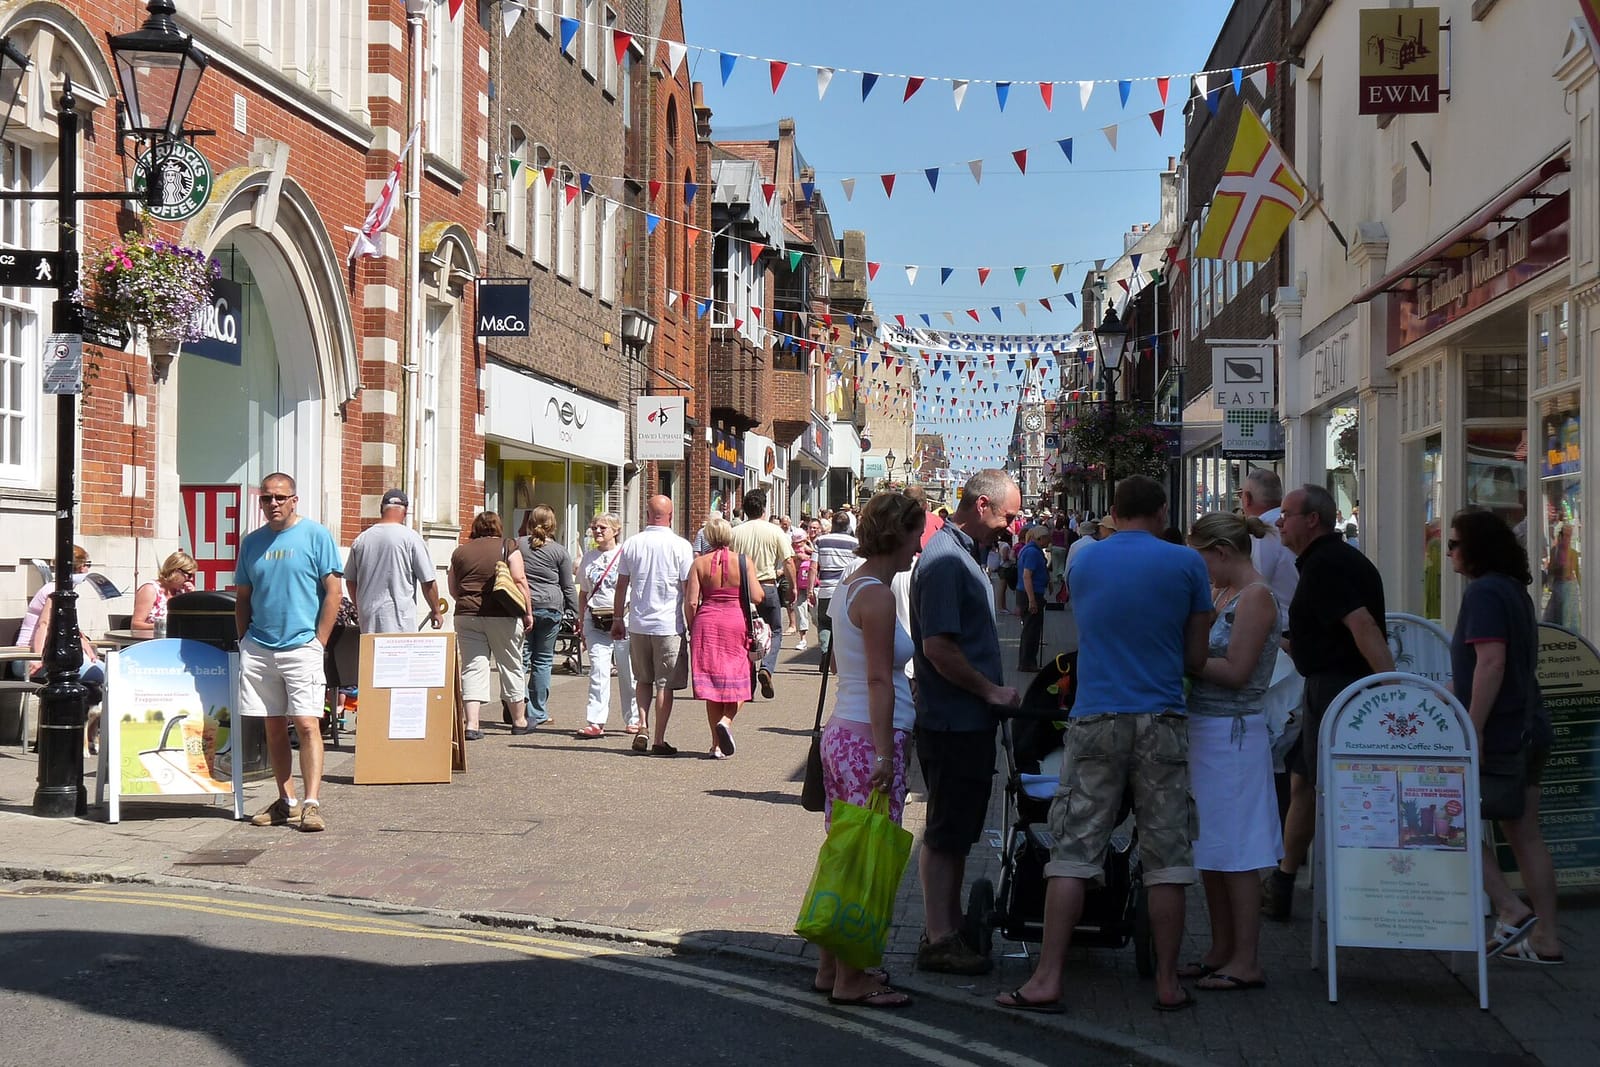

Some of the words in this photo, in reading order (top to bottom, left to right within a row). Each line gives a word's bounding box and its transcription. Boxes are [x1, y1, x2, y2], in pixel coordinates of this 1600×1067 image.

[1368, 85, 1430, 103] EWM
[150, 197, 197, 217] OFFEE
[480, 315, 526, 332] M&Co.
[949, 332, 1072, 342] DORCHESTER
[947, 340, 1071, 352] CARNIVAL
[1314, 333, 1349, 399] EAST
[1217, 391, 1270, 405] EAST
[1226, 439, 1267, 449] pharmacy
[1538, 641, 1577, 652] rees
[1548, 655, 1581, 664] Repairs
[195, 665, 227, 676] back
[1538, 671, 1570, 680] Cutting
[1348, 689, 1407, 731] Napper's
[1344, 741, 1389, 750] Restaurant
[1390, 742, 1407, 750] and
[1433, 743, 1454, 752] Shop
